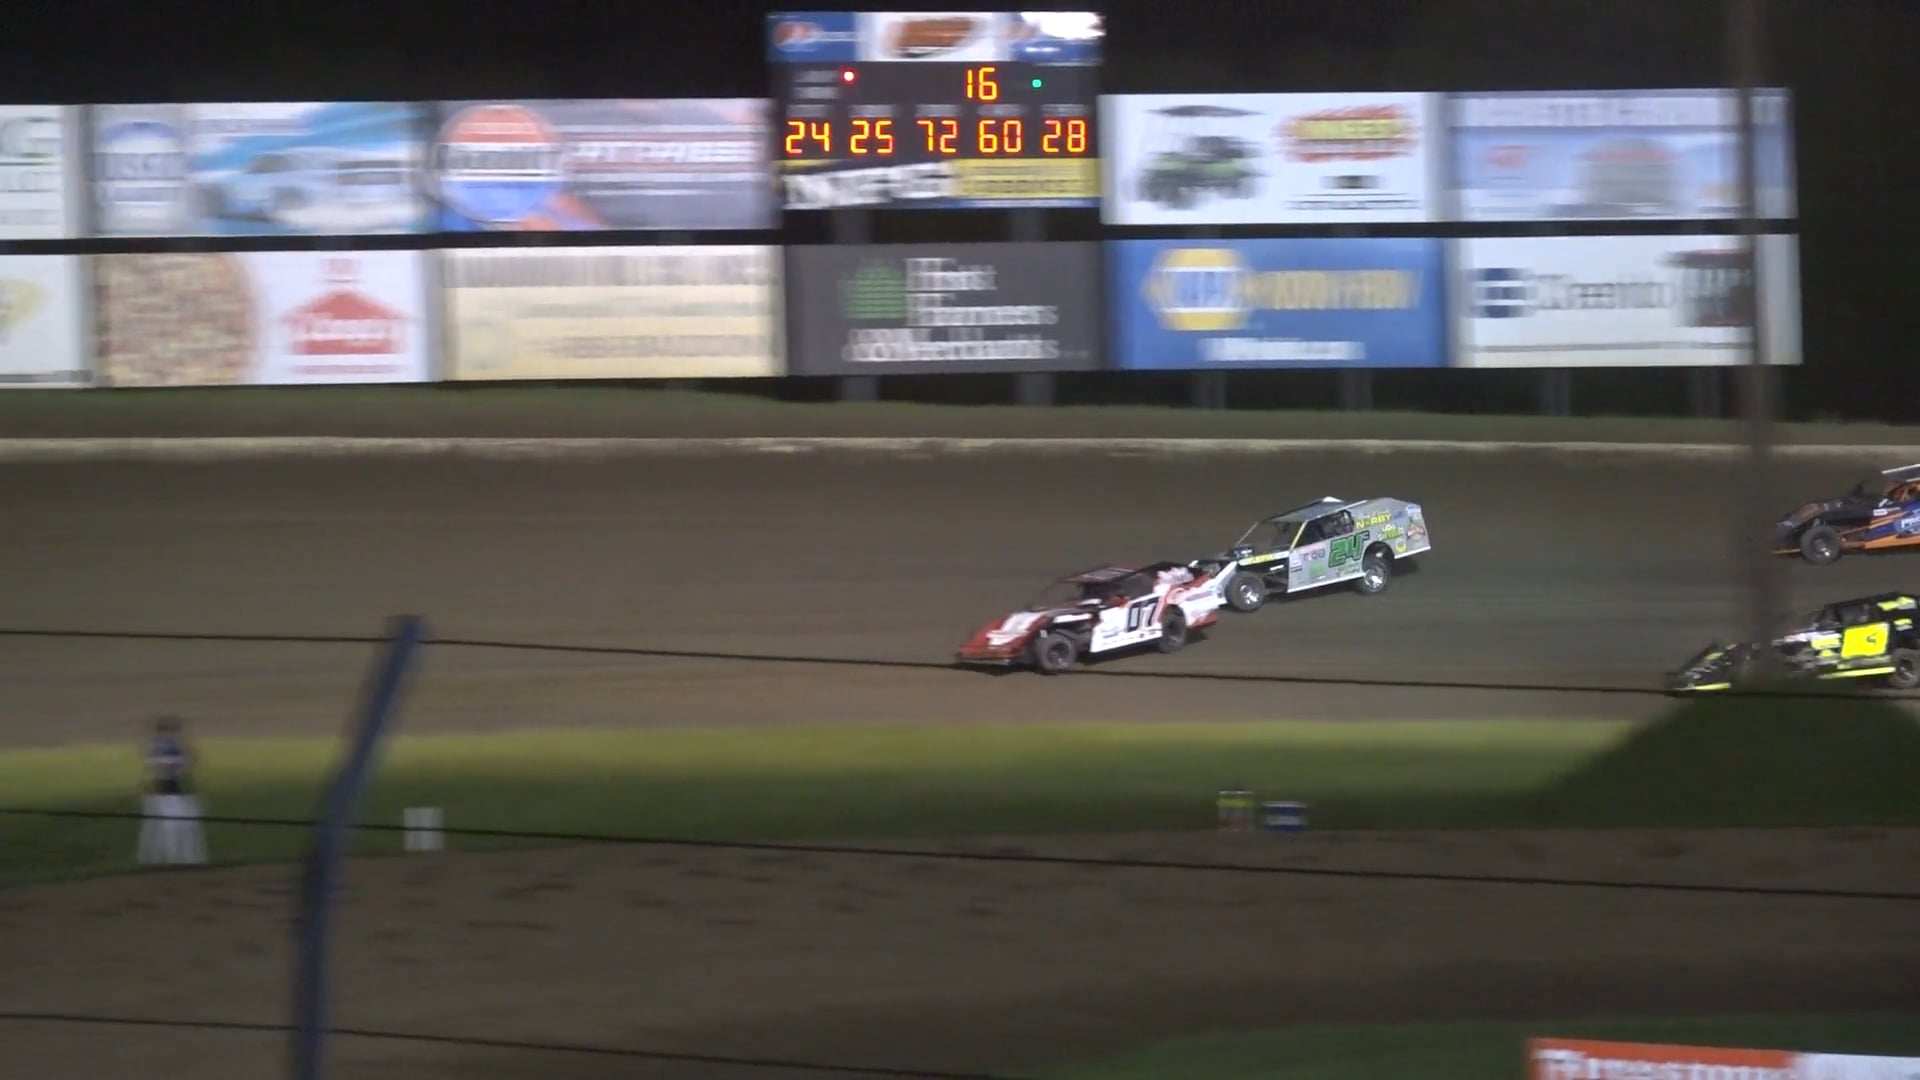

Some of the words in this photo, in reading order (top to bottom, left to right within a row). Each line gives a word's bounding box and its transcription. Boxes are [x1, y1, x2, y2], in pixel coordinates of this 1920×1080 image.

[967, 67, 997, 100] 16
[785, 120, 830, 153] 24
[850, 120, 894, 153] 25
[917, 120, 958, 153] 72
[979, 120, 1022, 153] 60
[1042, 120, 1087, 153] 28
[1126, 595, 1160, 633] 07
